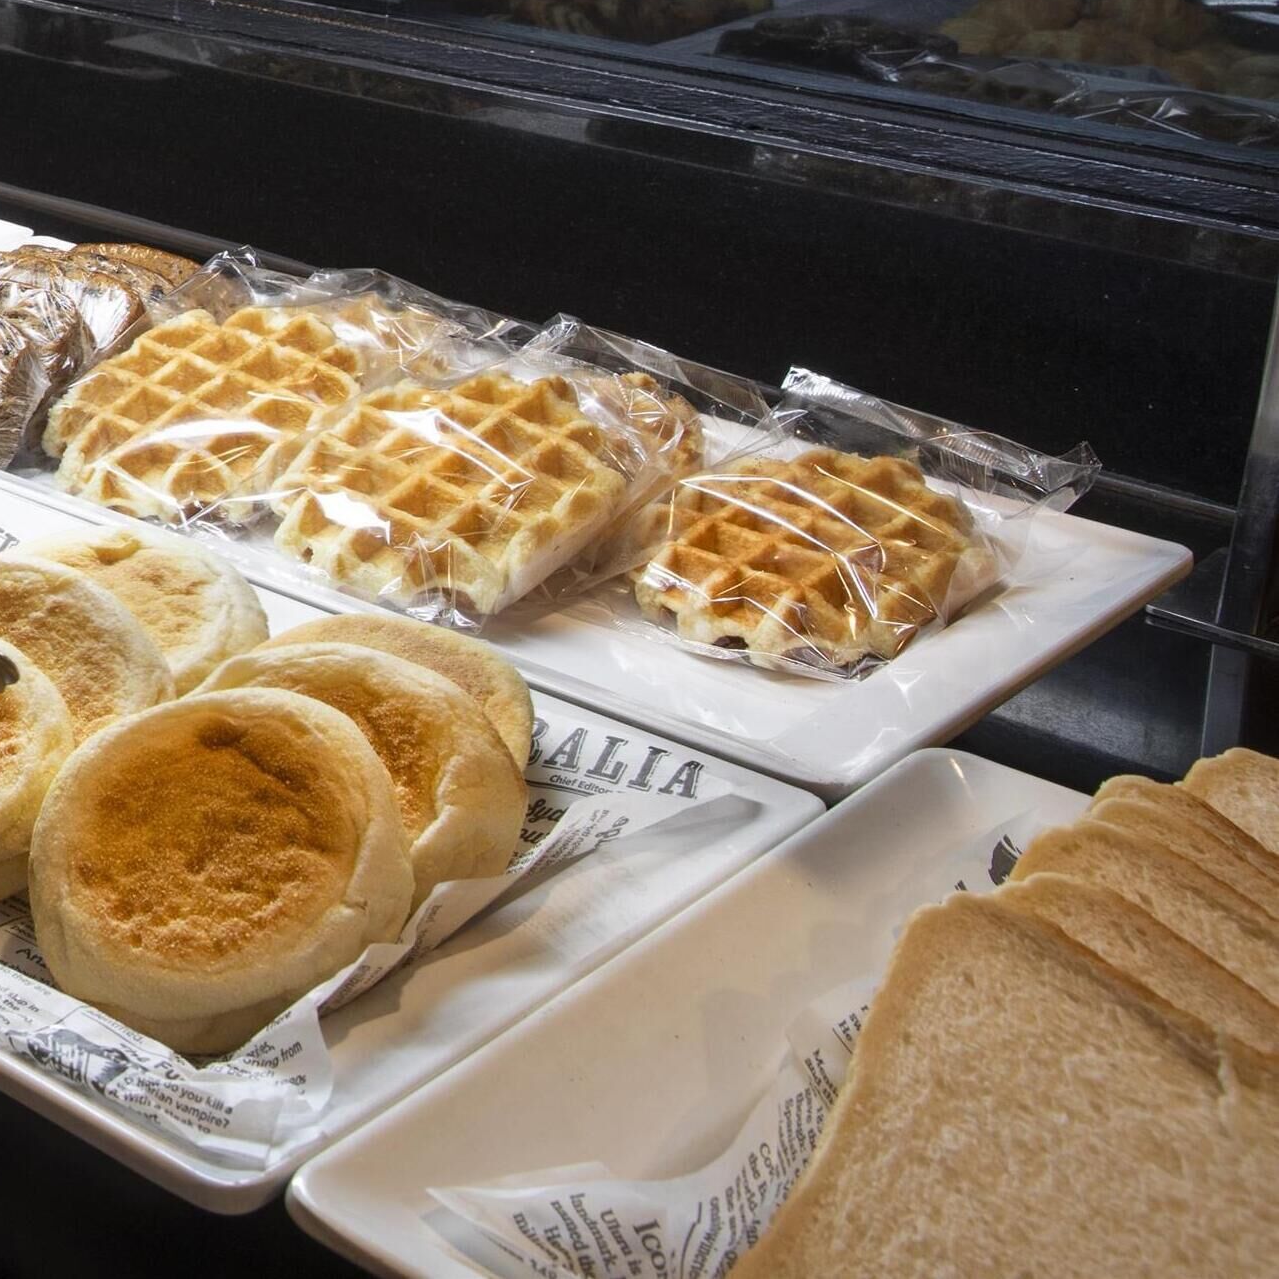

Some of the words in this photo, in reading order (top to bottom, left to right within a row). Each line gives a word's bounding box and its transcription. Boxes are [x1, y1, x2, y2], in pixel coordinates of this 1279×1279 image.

[548, 773, 579, 788] Chief
[280, 1040, 303, 1062] from
[181, 1088, 203, 1105] you
[205, 1092, 225, 1111] kill
[175, 1098, 231, 1130] vampire?
[550, 1200, 590, 1253] named
[600, 1207, 633, 1257] Uluru
[627, 1259, 642, 1277] is
